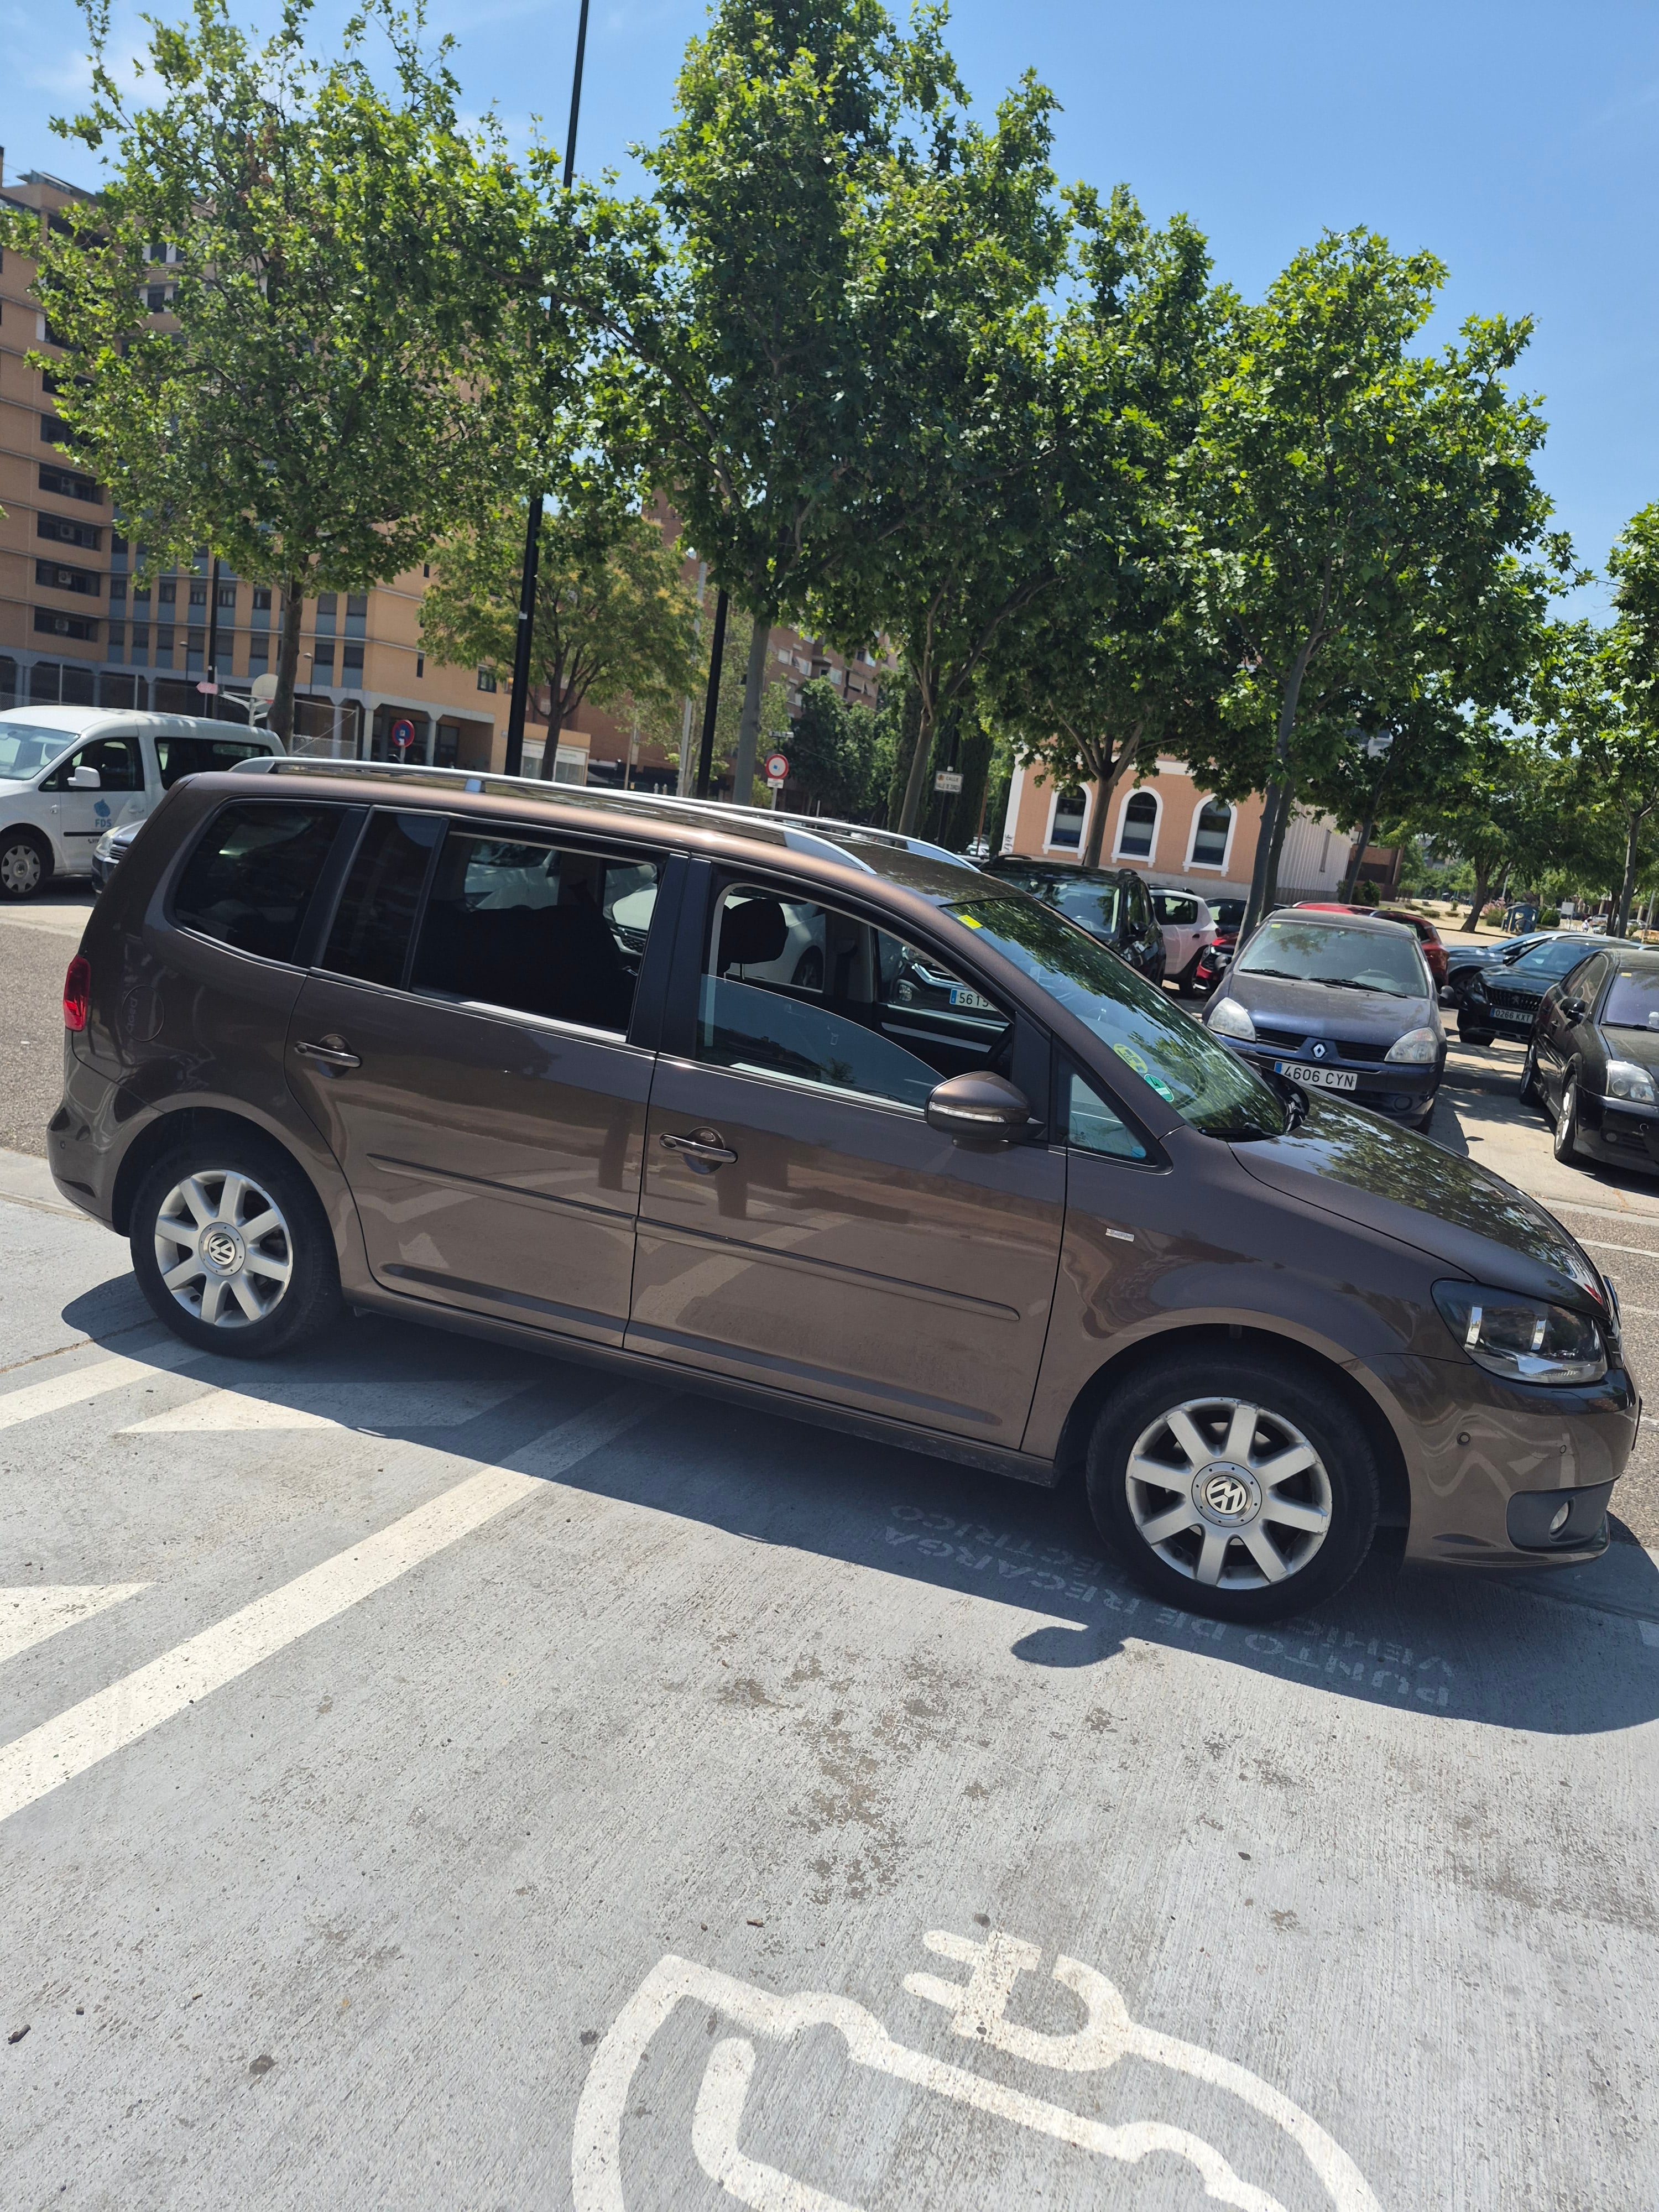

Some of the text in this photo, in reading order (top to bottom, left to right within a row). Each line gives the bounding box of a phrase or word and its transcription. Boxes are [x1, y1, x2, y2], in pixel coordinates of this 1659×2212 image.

[95, 818, 112, 827] FDS
[1495, 1010, 1531, 1022] 0266 KXT
[1284, 1066, 1354, 1088] 4606 CYN
[885, 1526, 1450, 1707] PUNTO DE RECARGA
